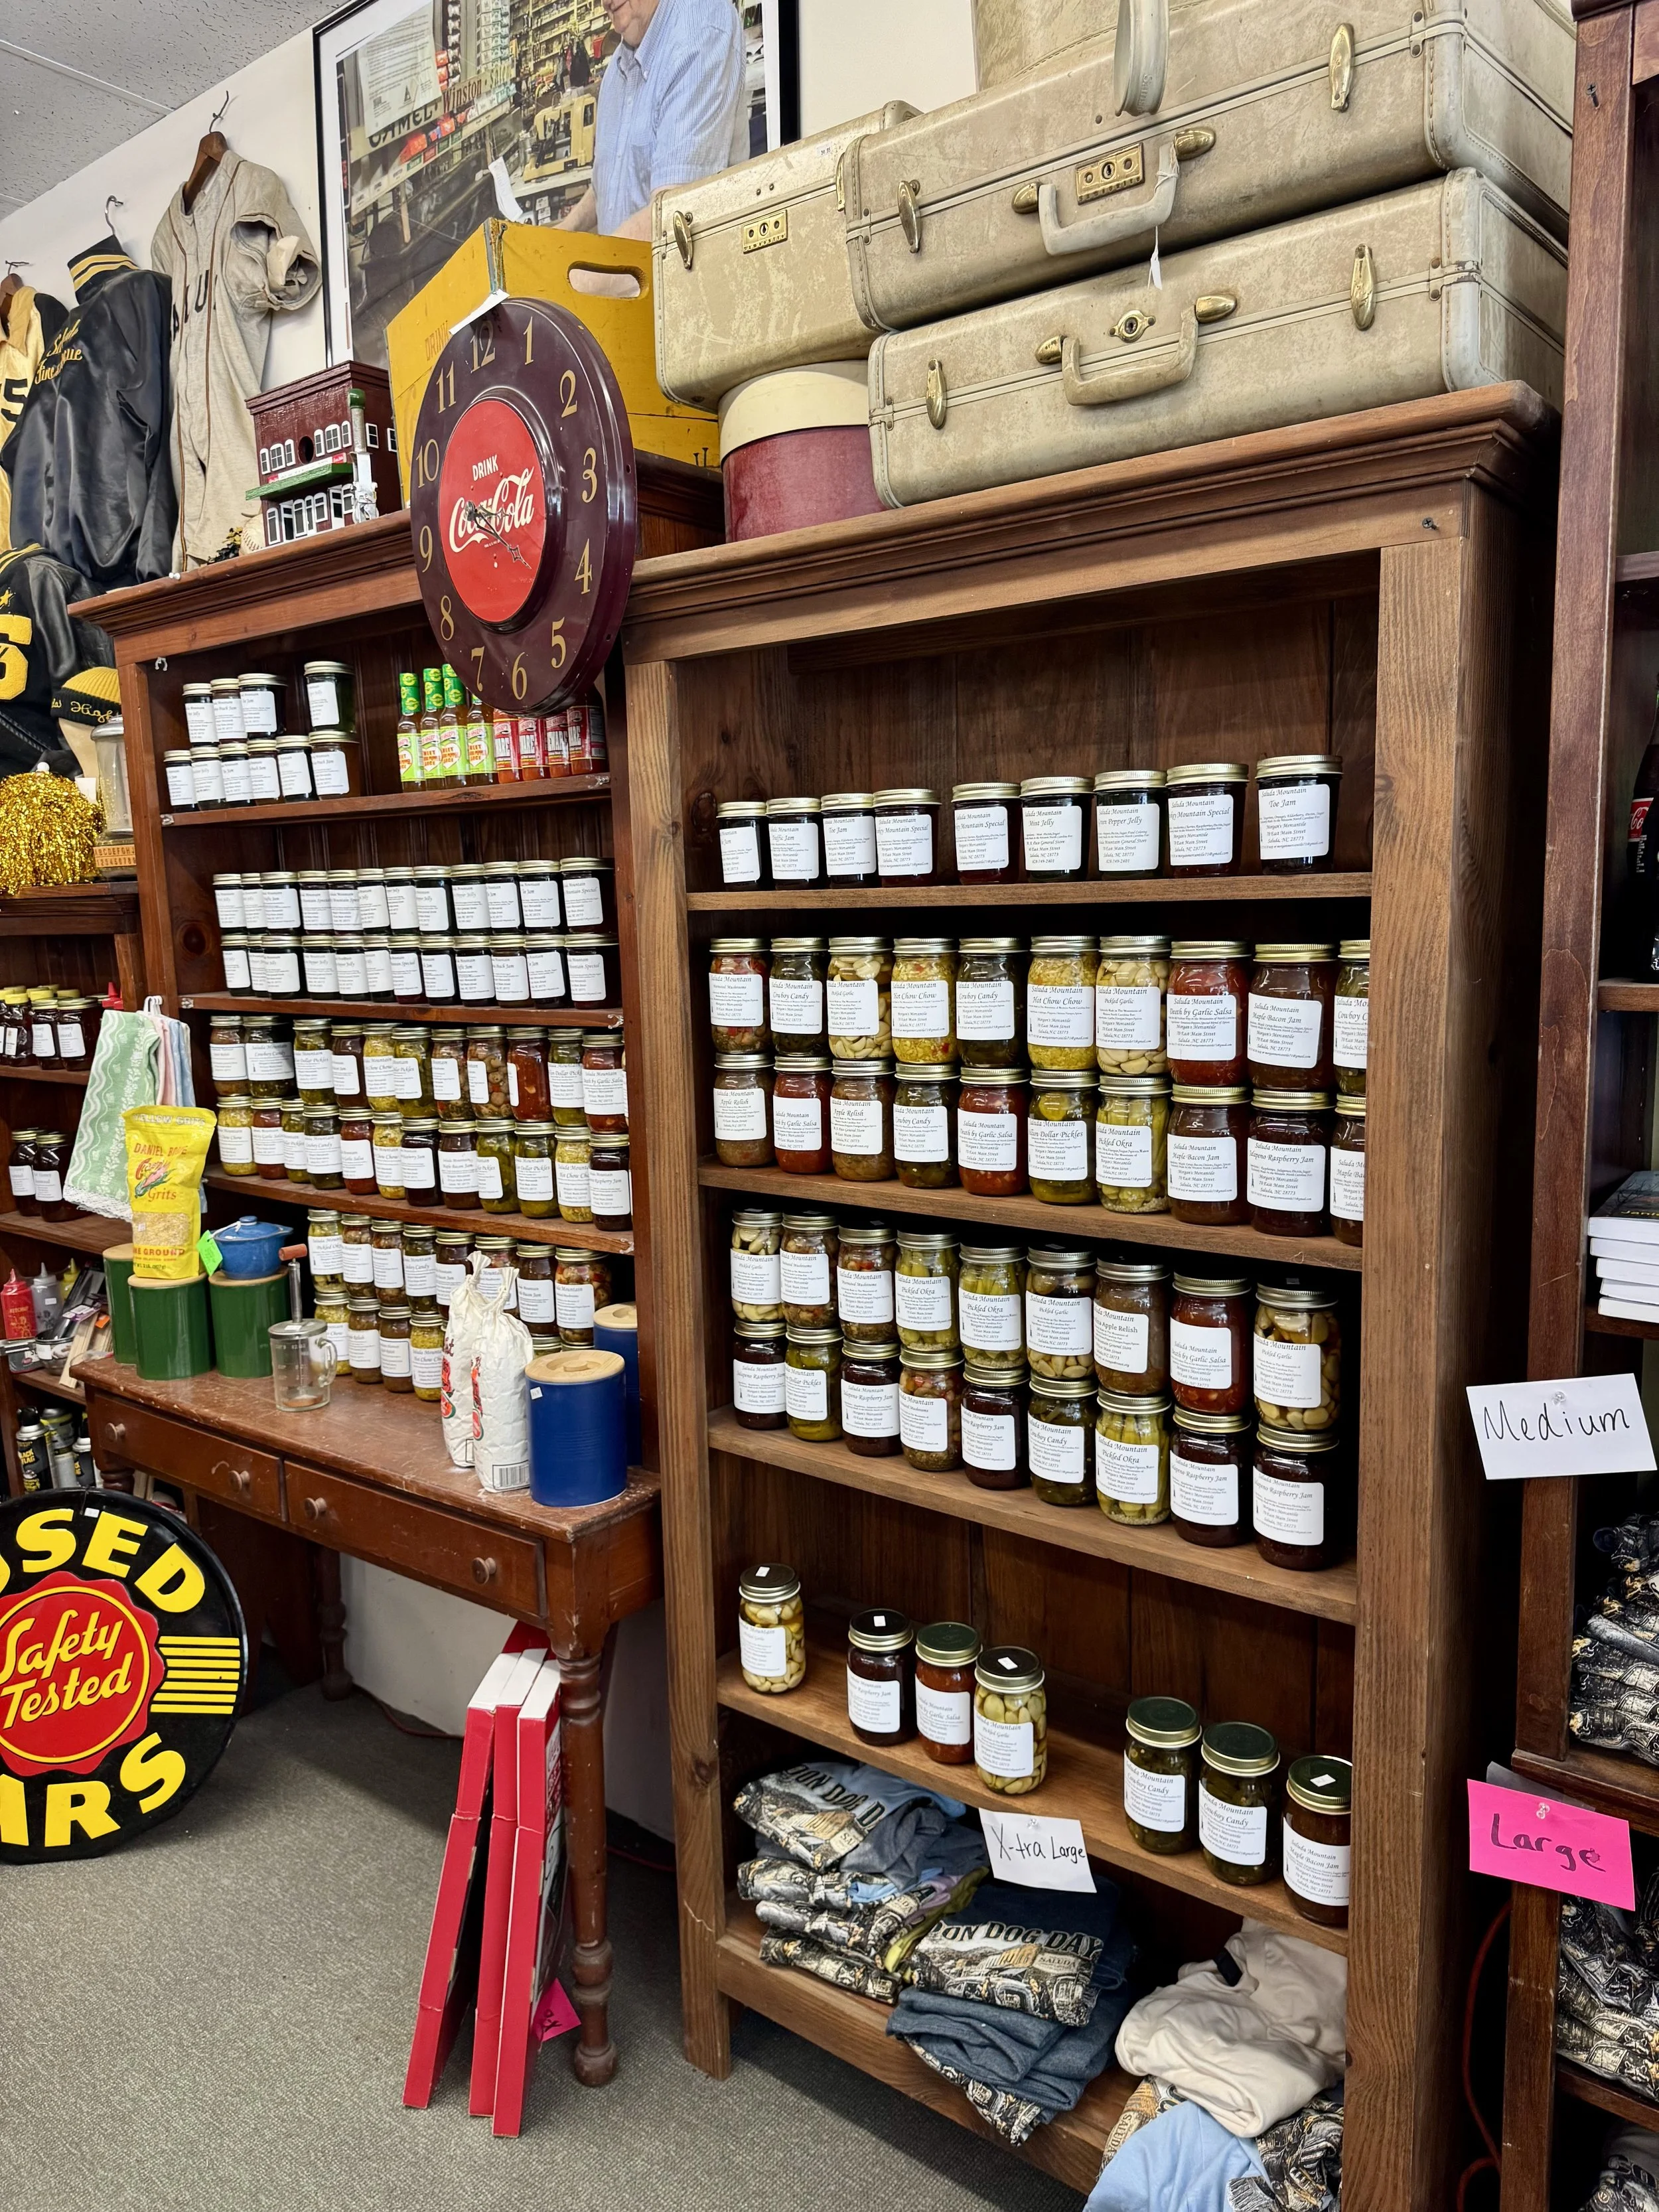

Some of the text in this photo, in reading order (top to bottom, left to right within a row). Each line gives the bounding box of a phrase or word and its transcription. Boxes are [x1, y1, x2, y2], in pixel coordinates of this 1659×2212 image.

[443, 79, 482, 113] Winston
[470, 320, 496, 374] 12
[523, 317, 534, 365] 1
[436, 361, 456, 413] 11
[559, 370, 577, 418] 2
[416, 439, 439, 488] 10
[472, 455, 498, 481] DRINK
[582, 447, 597, 503] 3
[449, 467, 535, 553] Coca-Cola
[419, 526, 433, 573] 9
[574, 538, 593, 595] 4
[440, 595, 455, 641] 8
[551, 617, 566, 668] 5
[471, 646, 485, 692] 7
[512, 652, 528, 700] 6
[1277, 787, 1307, 796] Mountain
[1281, 800, 1296, 808] Jam
[1207, 807, 1230, 816] Special
[1338, 1011, 1360, 1020] Cowboy
[176, 1116, 205, 1126] GRITS
[133, 1143, 163, 1156] DANIEL
[1116, 1140, 1132, 1148] Okra
[1267, 1154, 1299, 1165] Raspberry
[148, 1188, 177, 1202] Grits
[143, 1247, 184, 1256] GROUND
[1104, 1311, 1134, 1323] Mountain
[1102, 1321, 1138, 1333] Apple Relish
[1269, 1341, 1306, 1351] Mountain
[1189, 1353, 1208, 1363] Garlic
[906, 1396, 934, 1406] Mountain
[970, 1420, 992, 1431] Raspberry
[1484, 1400, 1630, 1441] Medium
[1041, 1424, 1072, 1434] Mountain
[1047, 1436, 1067, 1445] Candy
[1114, 1444, 1147, 1453] Mountain
[1102, 1449, 1139, 1464] Pickled Okra
[1187, 1470, 1214, 1482] Raspberry
[1273, 1479, 1300, 1489] Mountain
[1269, 1487, 1298, 1499] Raspberry
[0, 1609, 125, 1686] Safety
[0, 1651, 135, 1730] Tested
[1140, 1770, 1173, 1784] Mountain
[1147, 1785, 1169, 1795] Candy
[1218, 1801, 1254, 1816] Mountain
[1226, 1814, 1249, 1826] Candy
[991, 1822, 1085, 1864] X-tra Large
[1490, 1813, 1607, 1872] Large
[1307, 1848, 1336, 1860] Mountain
[985, 1921, 1104, 1958] DOG DAY
